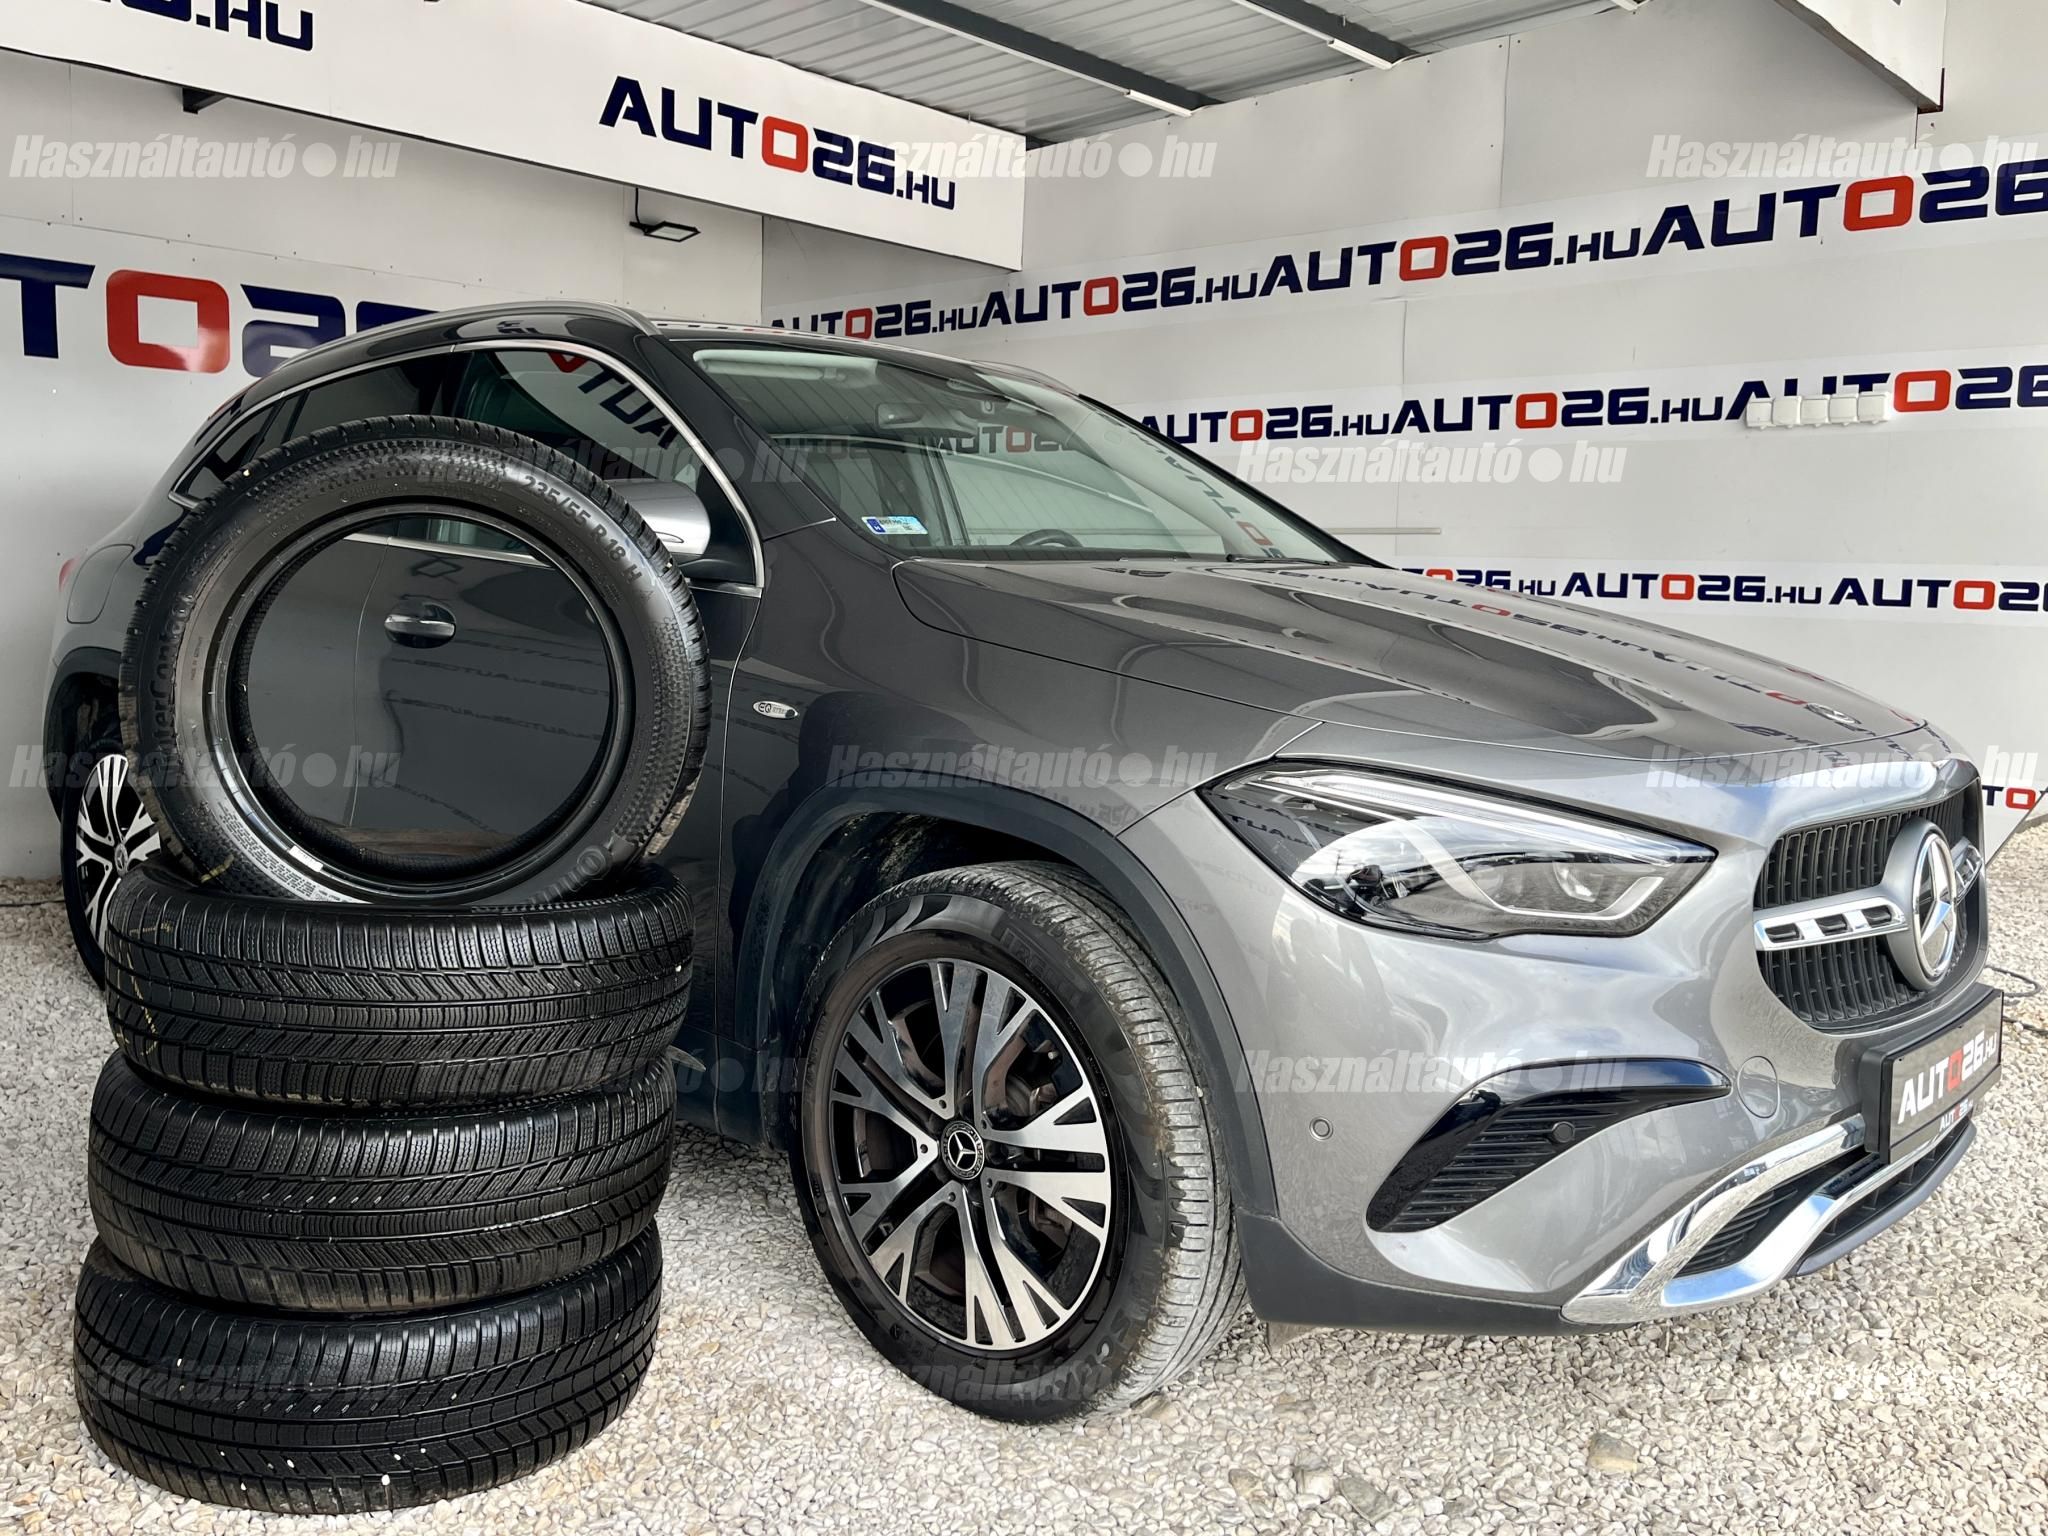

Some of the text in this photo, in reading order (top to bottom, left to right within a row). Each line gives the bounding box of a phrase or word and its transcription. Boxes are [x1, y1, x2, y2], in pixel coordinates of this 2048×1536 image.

[599, 76, 956, 211] AUTO26.HU
[0, 252, 438, 378] TO2
[979, 266, 1258, 328] AUTO26.HU
[1259, 222, 1641, 298] AUTO26.HU
[1391, 387, 1724, 435] AUTO26.HU
[523, 475, 592, 528] 235/55
[605, 537, 627, 562] 18
[1562, 572, 1821, 605] AUTO26.HU
[1829, 578, 2048, 612] AUTO2
[1898, 1030, 1997, 1125] AUTO26.HU
